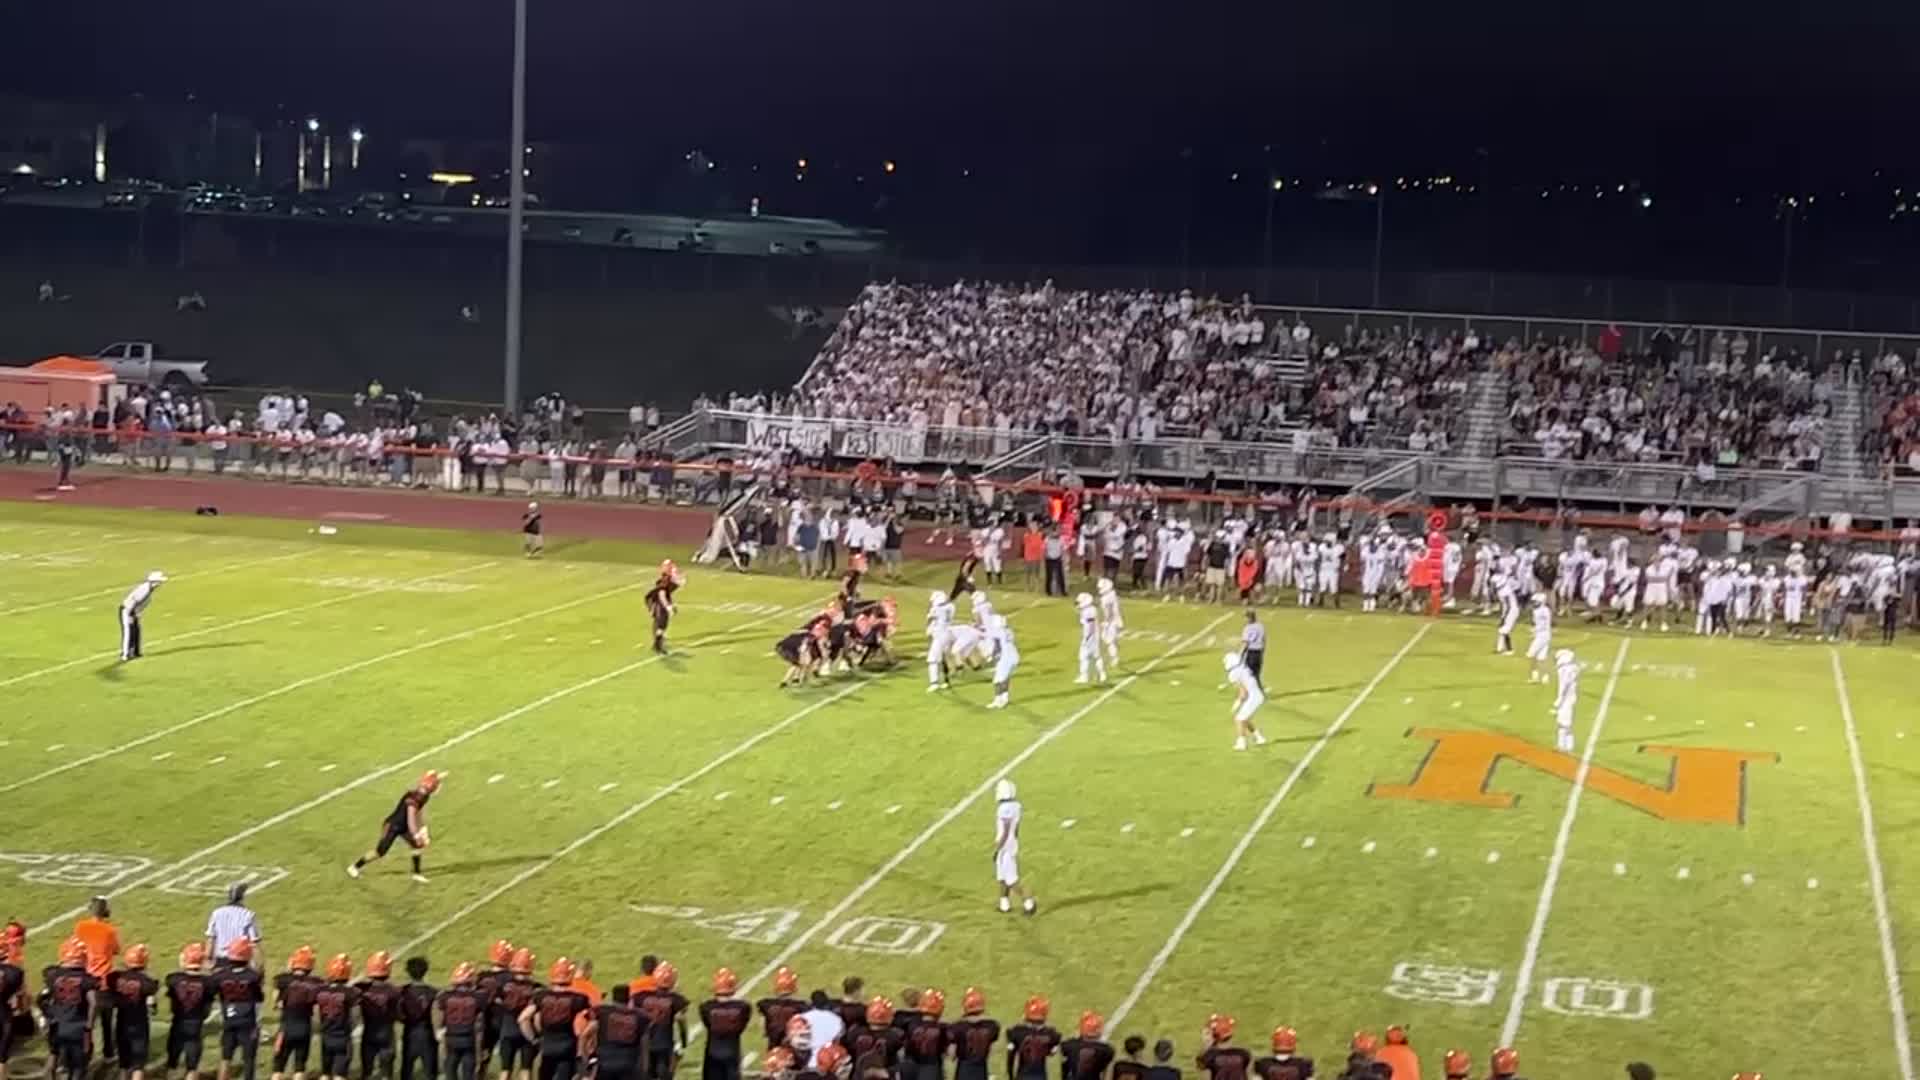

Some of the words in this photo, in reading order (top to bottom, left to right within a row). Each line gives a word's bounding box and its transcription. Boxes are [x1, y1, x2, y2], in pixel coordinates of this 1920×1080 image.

[751, 422, 792, 450] WEST
[1365, 726, 1780, 828] N
[694, 906, 948, 955] 40
[1382, 962, 1656, 1020] 50
